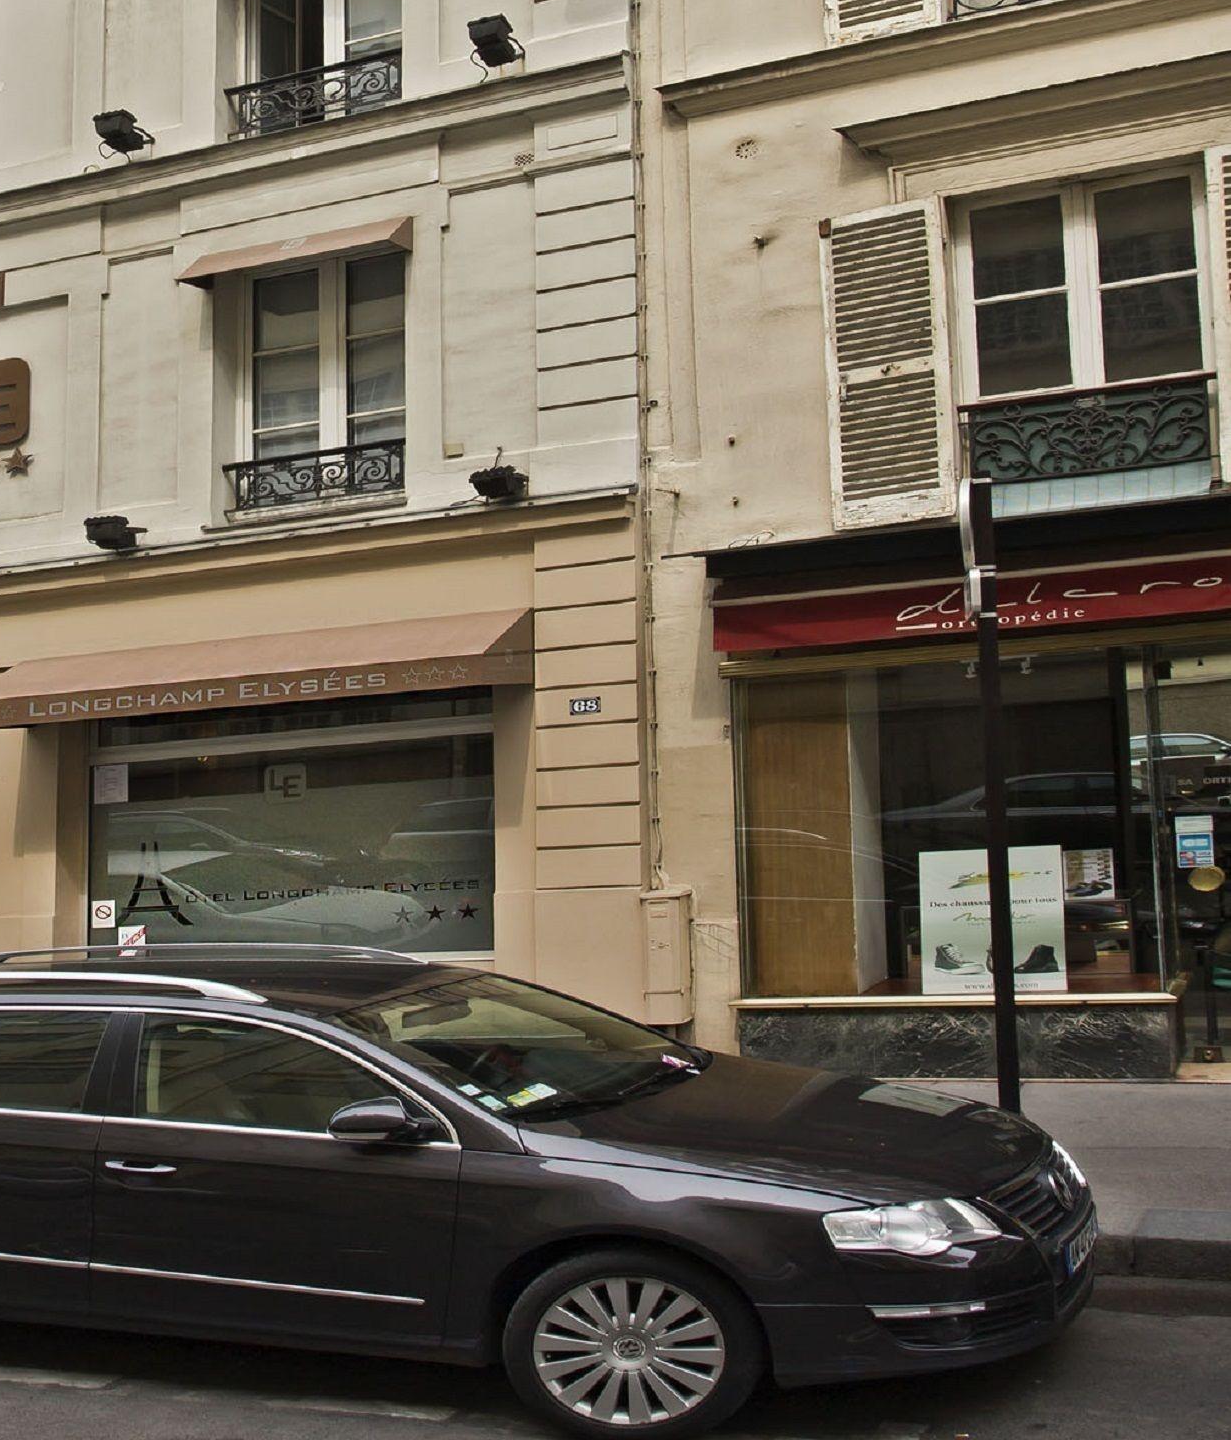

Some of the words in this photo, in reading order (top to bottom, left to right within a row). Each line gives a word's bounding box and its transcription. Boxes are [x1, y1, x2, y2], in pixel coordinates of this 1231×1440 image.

[941, 607, 1086, 630] ortopédie
[28, 688, 226, 718] LONGCHAMP
[238, 671, 387, 701] ELYSÉES
[573, 699, 598, 712] 68
